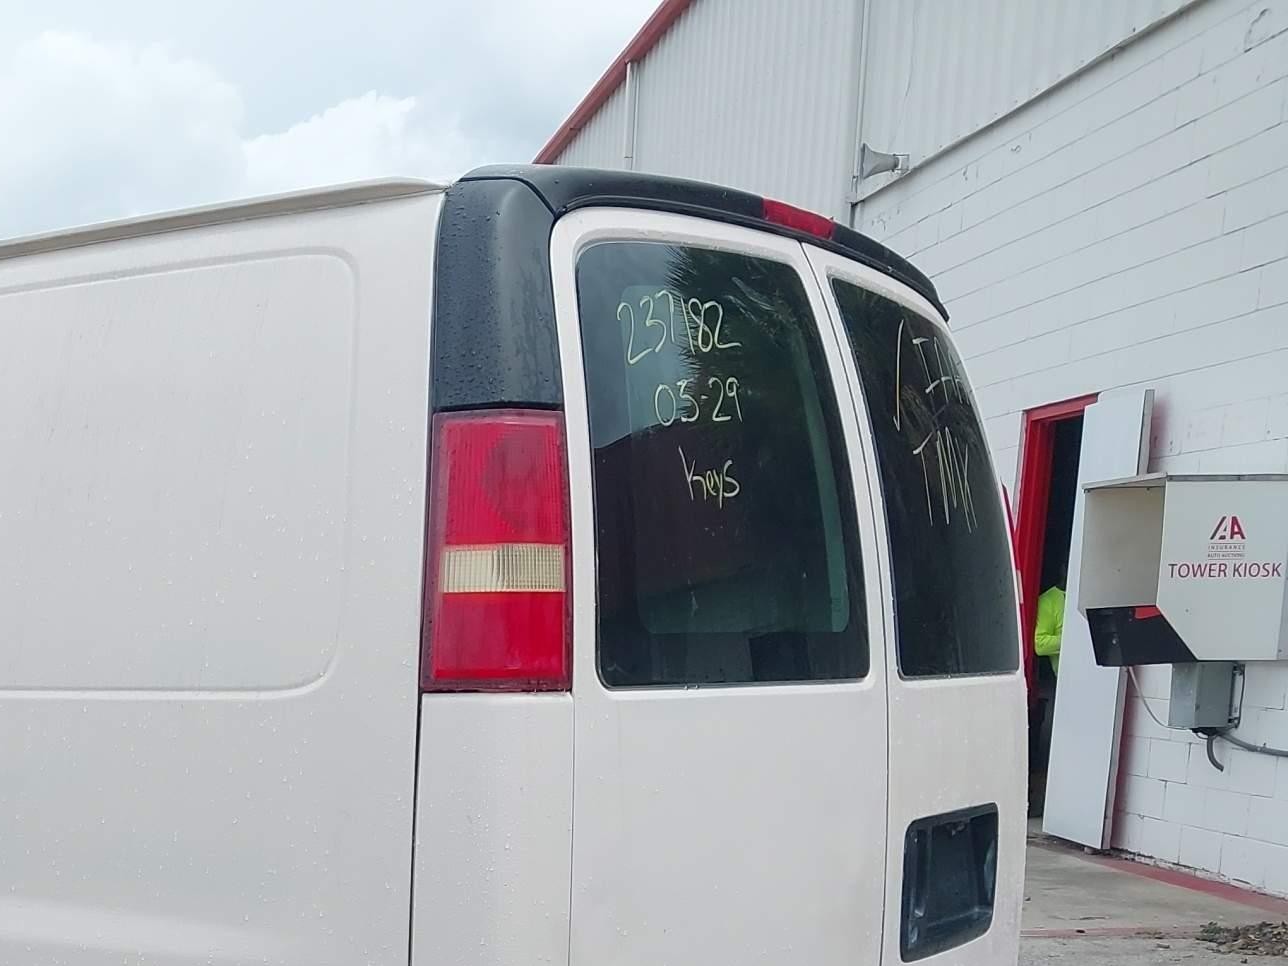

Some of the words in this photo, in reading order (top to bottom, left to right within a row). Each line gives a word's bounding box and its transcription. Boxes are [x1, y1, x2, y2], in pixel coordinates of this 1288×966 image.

[616, 289, 743, 365] 237182
[653, 376, 744, 427] 05-29
[677, 445, 742, 510] Keys
[1168, 562, 1228, 578] TOWER
[1232, 562, 1283, 578] KIOSK
